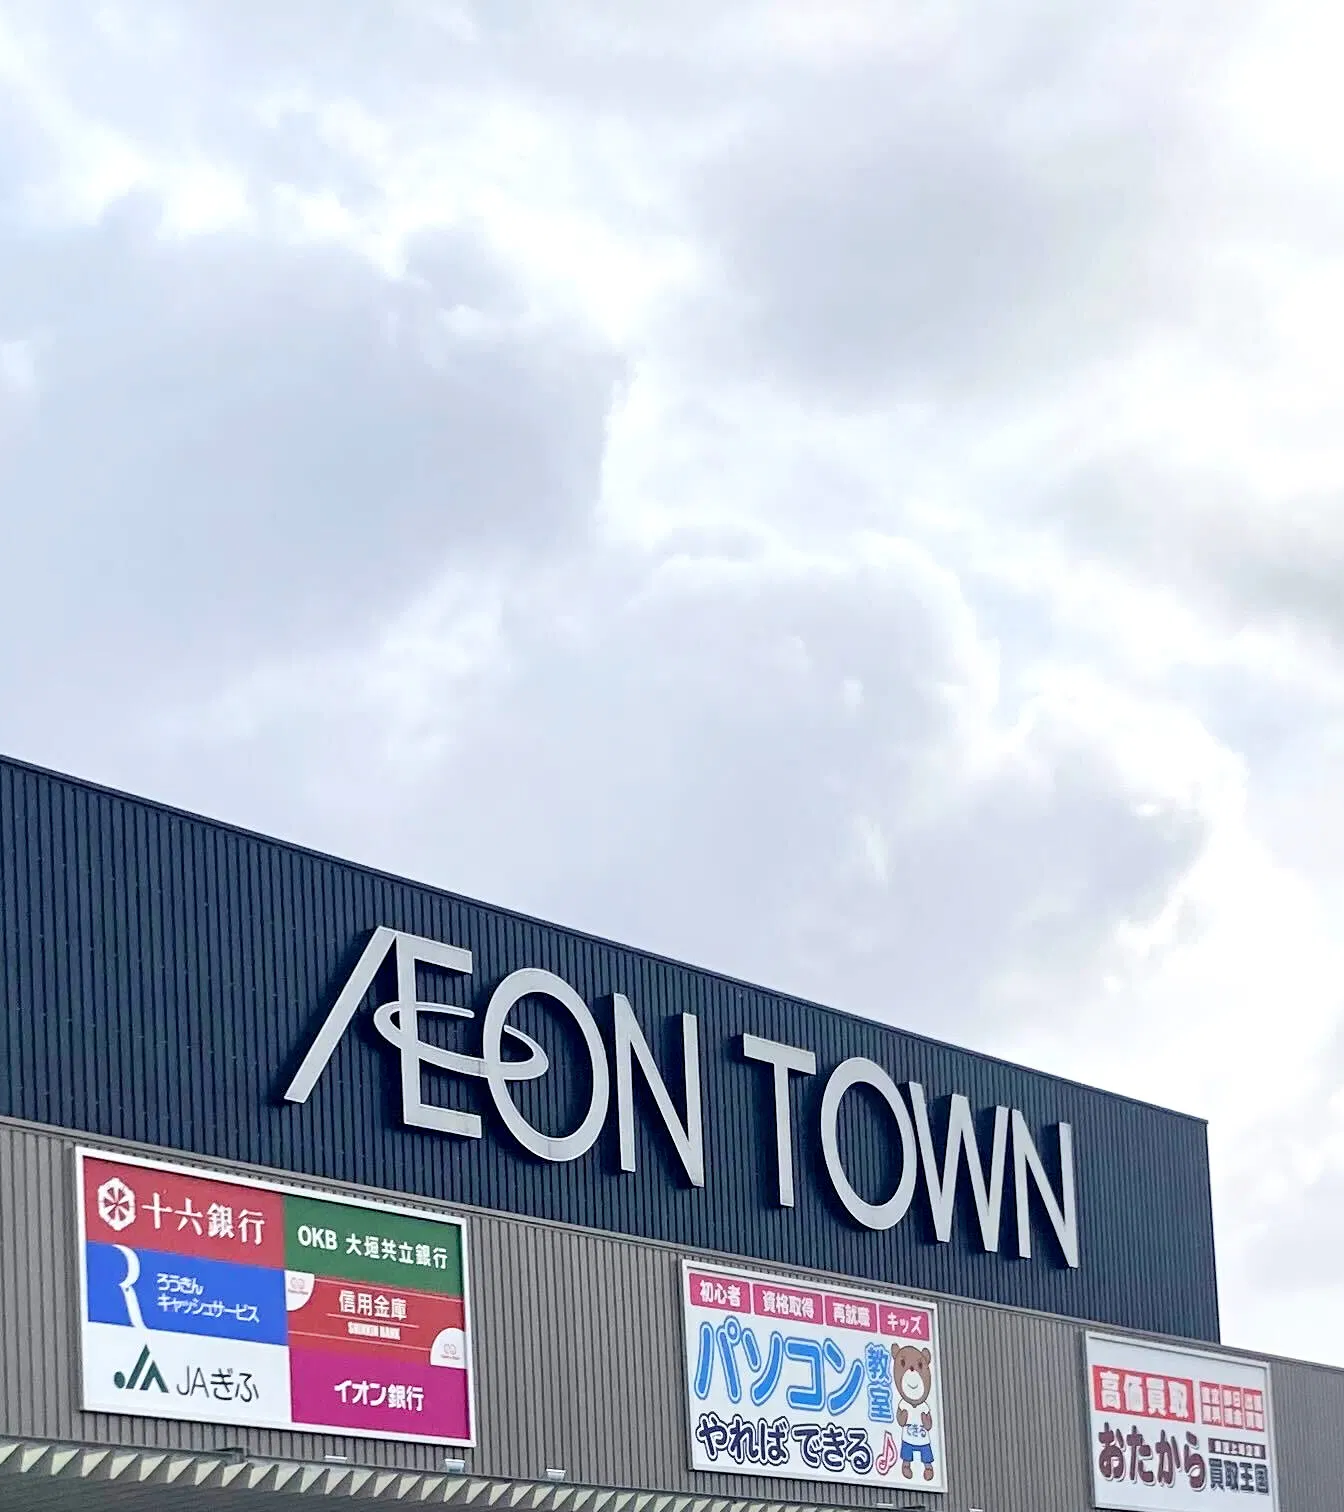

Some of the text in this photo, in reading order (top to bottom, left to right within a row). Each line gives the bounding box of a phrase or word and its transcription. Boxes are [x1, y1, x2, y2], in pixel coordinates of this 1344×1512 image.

[741, 1032, 1079, 1269] TOWN
[141, 1192, 266, 1246] 十六銀行
[297, 1225, 449, 1270] OKB 大垣共立銀行
[156, 1273, 204, 1295] ろうきん
[699, 1280, 742, 1308] 初心者
[157, 1295, 261, 1324] キャッシュサービス
[338, 1290, 408, 1321] 信用金庫
[762, 1290, 815, 1320] 資格取得
[887, 1311, 922, 1335] キッズ
[694, 1315, 864, 1416] パソコン
[175, 1366, 260, 1403] JAぎふ
[333, 1379, 425, 1413] イオン銀行
[1098, 1422, 1206, 1492] おたから
[1208, 1458, 1269, 1495] 買取王国
